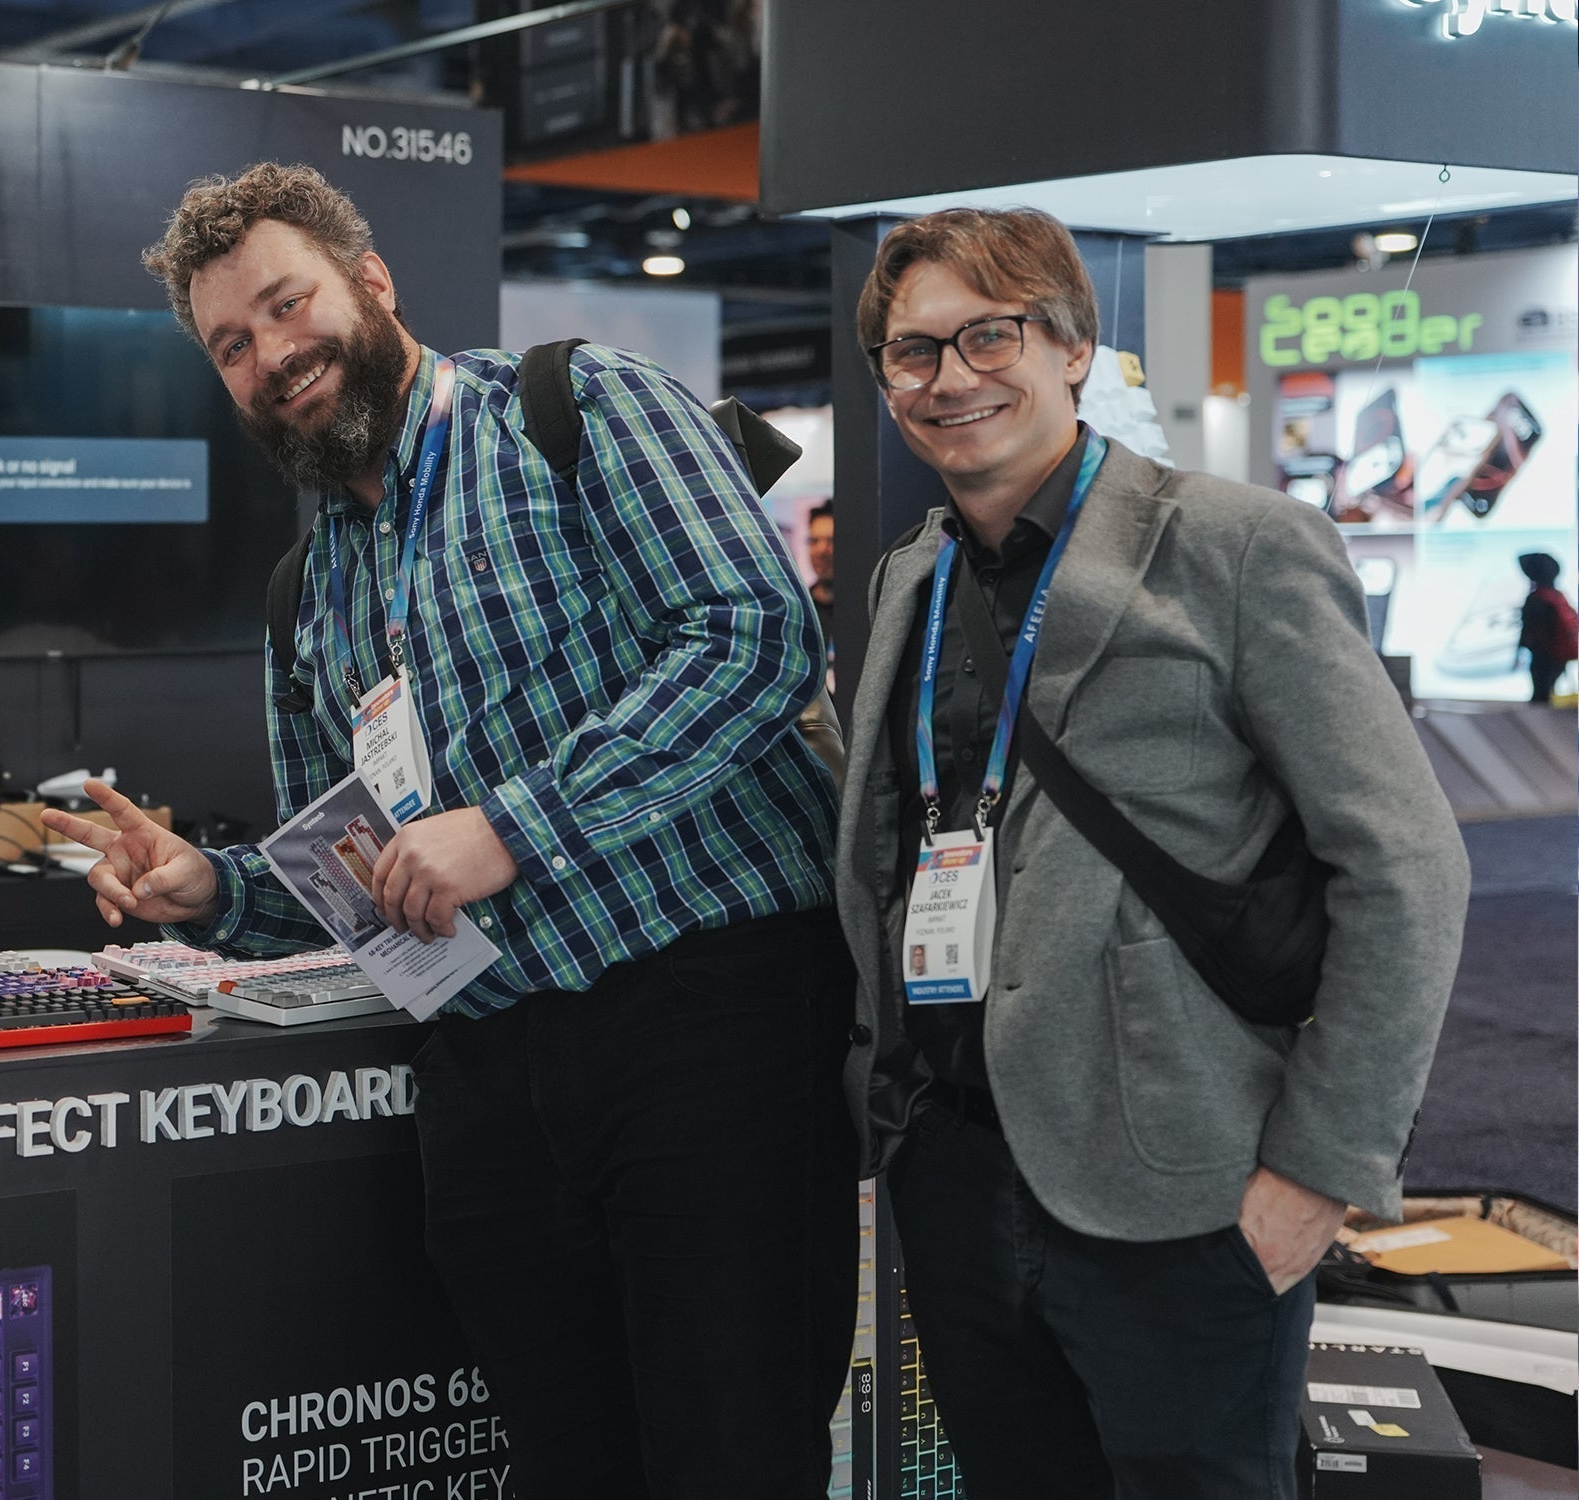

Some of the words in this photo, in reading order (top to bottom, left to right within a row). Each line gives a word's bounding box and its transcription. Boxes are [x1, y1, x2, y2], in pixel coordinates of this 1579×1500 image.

[342, 125, 472, 165] NO.31546
[6, 459, 20, 474] or
[22, 459, 38, 474] no
[39, 457, 77, 477] signal
[409, 517, 419, 539] Sony
[414, 487, 426, 516] Honda
[420, 450, 437, 486] Mobility
[933, 577, 946, 619] Mobility
[928, 620, 940, 654] Honda
[924, 656, 935, 682] Sony
[372, 711, 388, 731] CES
[361, 730, 398, 766] JASTRZEBSKI
[365, 727, 390, 751] MICHAL
[393, 798, 416, 818] ATTENDEE
[302, 811, 325, 831] Syntech
[938, 870, 959, 883] CES
[380, 936, 409, 958] MECHANICAL
[140, 1064, 416, 1144] KEYBOARD
[22, 1361, 29, 1372] F1
[22, 1393, 29, 1405] F2
[241, 1373, 436, 1442] CHRONOS
[447, 1366, 490, 1407] 68
[862, 1373, 871, 1413] G-68
[22, 1425, 30, 1438] F3
[22, 1458, 30, 1470] F4
[242, 1443, 351, 1497] RAPID
[360, 1415, 510, 1474] TRIGGER
[447, 1464, 512, 1500] KEY
